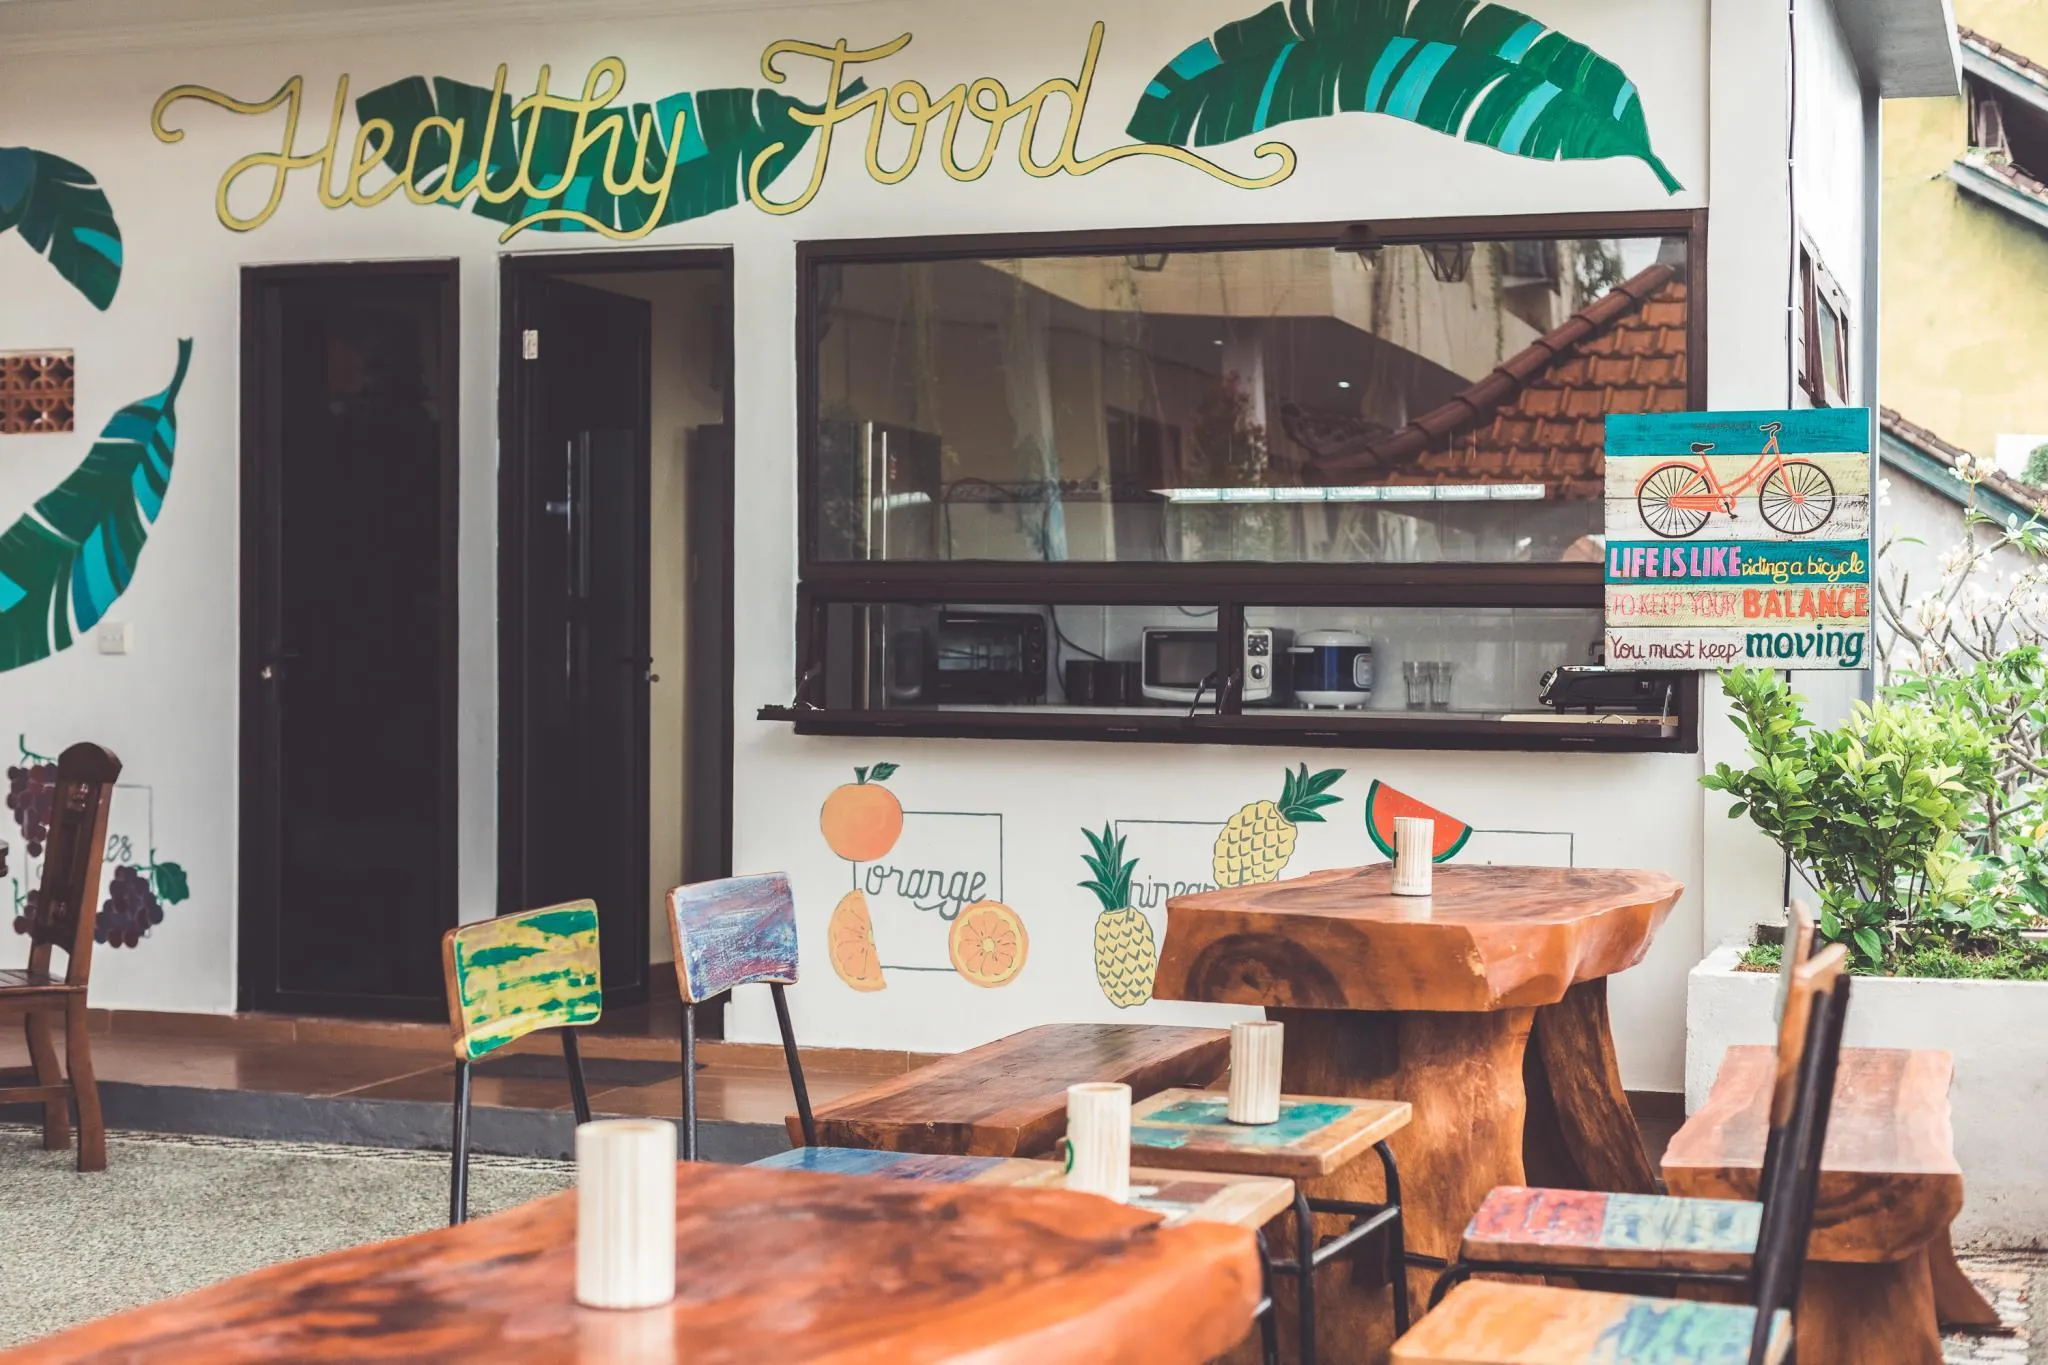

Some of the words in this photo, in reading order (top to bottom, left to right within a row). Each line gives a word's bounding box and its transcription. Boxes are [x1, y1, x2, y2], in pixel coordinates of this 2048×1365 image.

[151, 56, 686, 244] Healthy
[748, 21, 1297, 216] Food
[1609, 547, 1659, 577] LIFE
[1662, 547, 1687, 577] IS
[1690, 546, 1741, 577] LIKE
[1742, 556, 1789, 584] riding
[1790, 561, 1805, 575] a
[1807, 551, 1866, 582] bicycle
[1610, 593, 1635, 616] TO
[1639, 591, 1684, 617] KEEP
[1687, 591, 1739, 618] YOUR
[1743, 587, 1869, 620] BALANCE
[1611, 636, 1645, 659] You
[1649, 640, 1694, 659] must
[1699, 639, 1743, 663] keep
[1746, 624, 1865, 667] moving
[865, 865, 987, 921] orange
